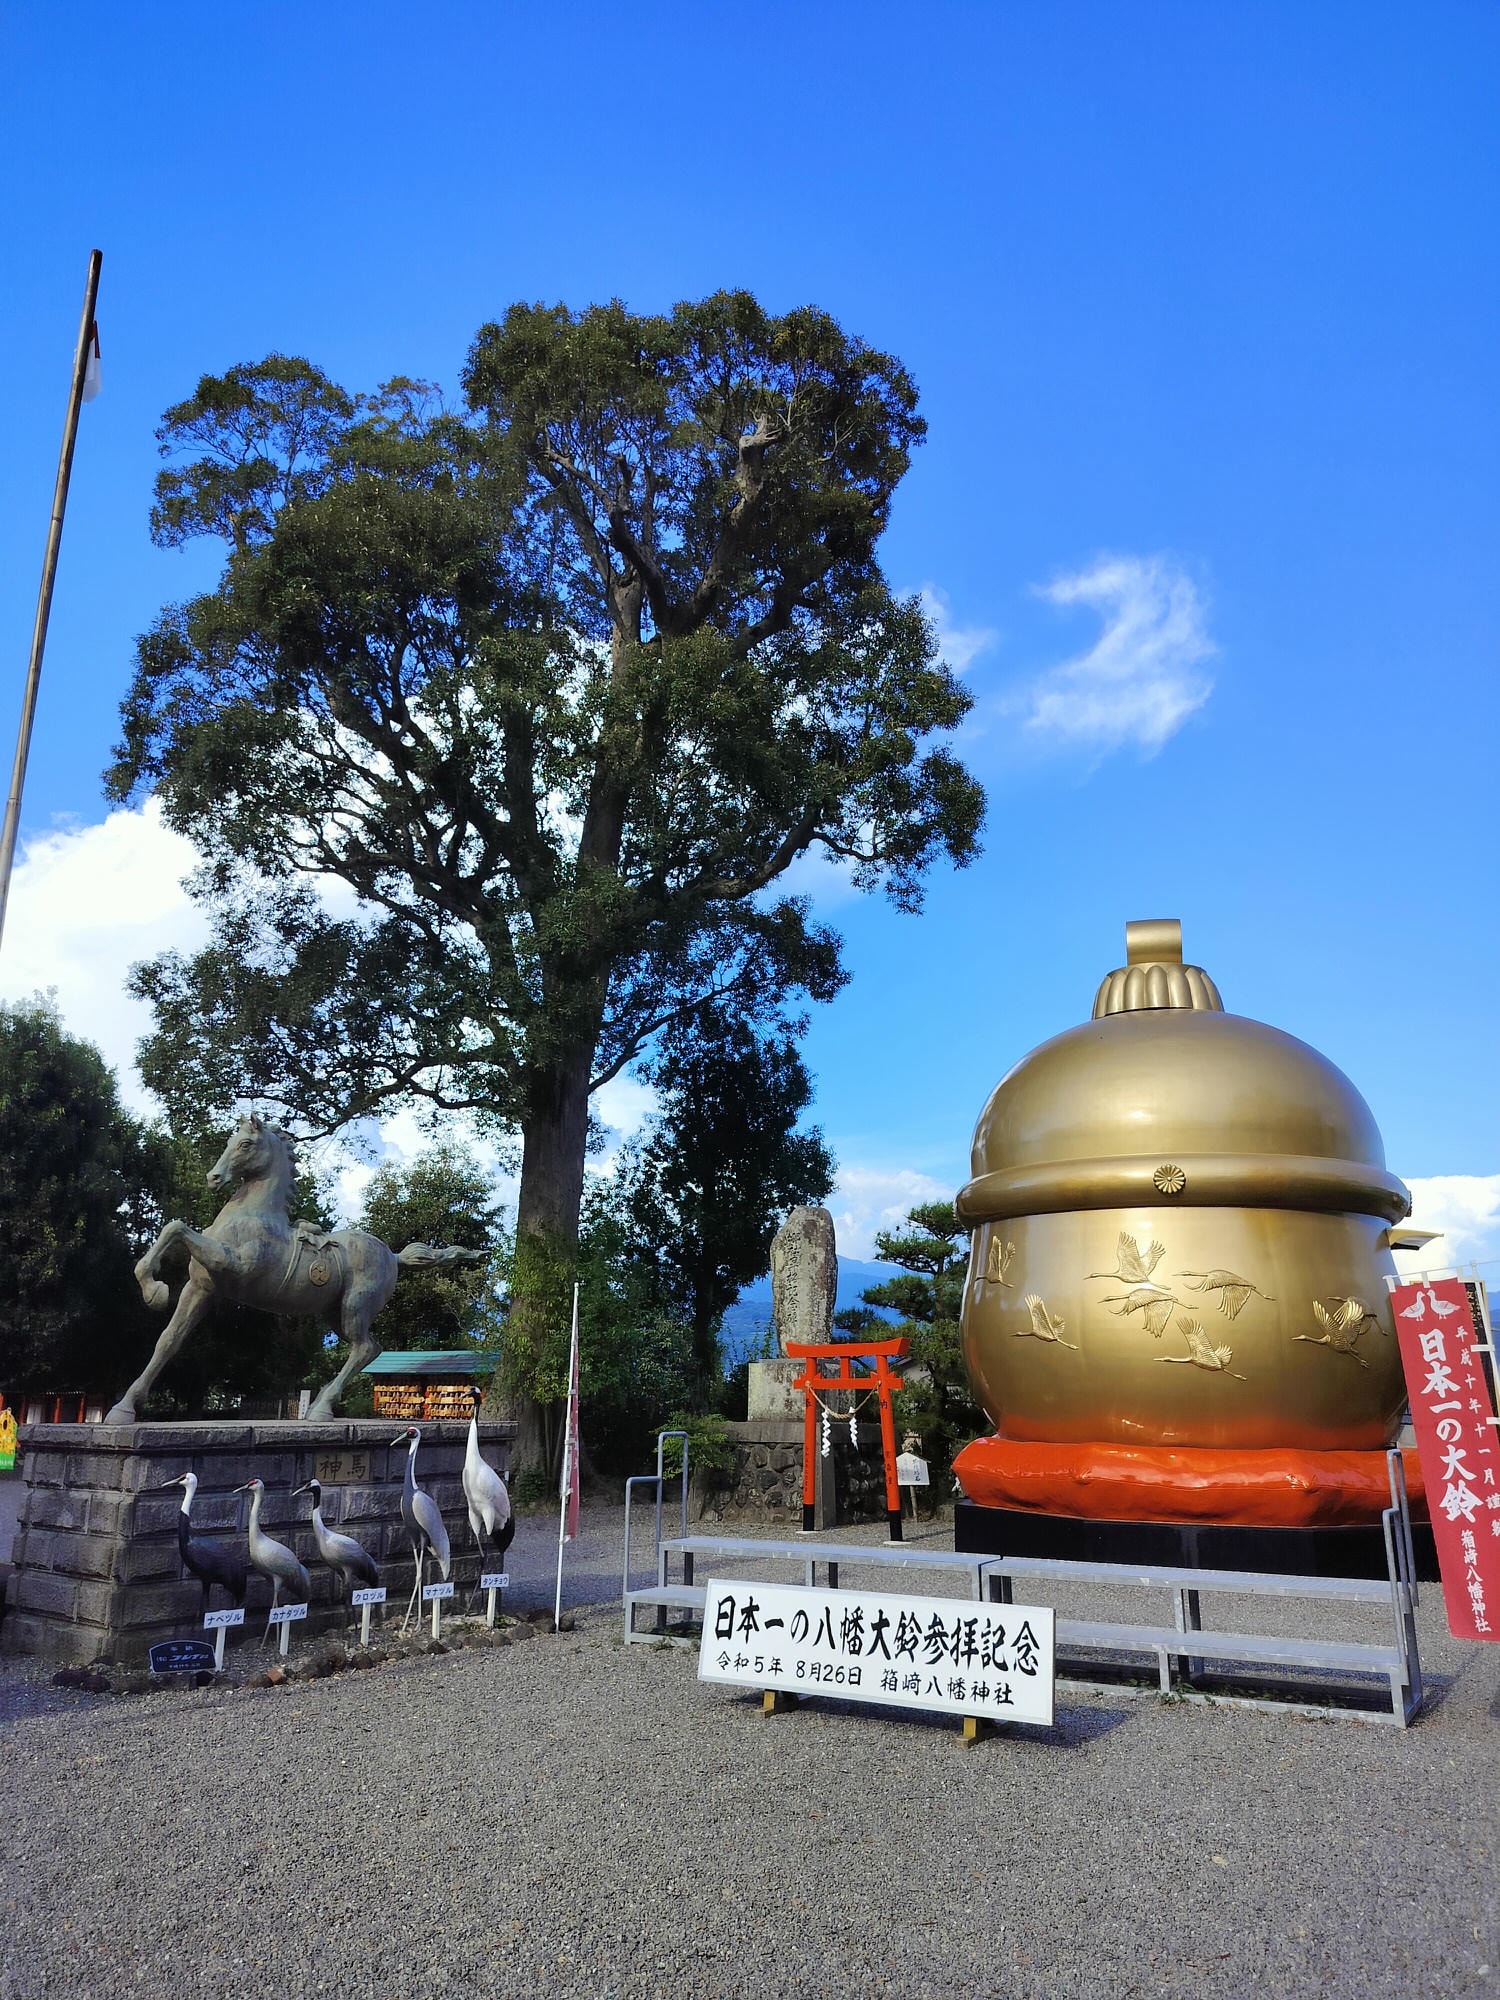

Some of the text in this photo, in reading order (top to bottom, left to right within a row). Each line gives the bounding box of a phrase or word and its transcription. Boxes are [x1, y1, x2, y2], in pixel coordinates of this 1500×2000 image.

[1418, 1328, 1484, 1523] 日本一の大鈴
[319, 1454, 366, 1480] 神馬
[482, 1576, 508, 1586] タンチョウ
[354, 1590, 384, 1602] クロヅル
[425, 1584, 453, 1596] マナヅル
[207, 1612, 242, 1626] ナベヅル
[272, 1606, 306, 1621] カナダヅル
